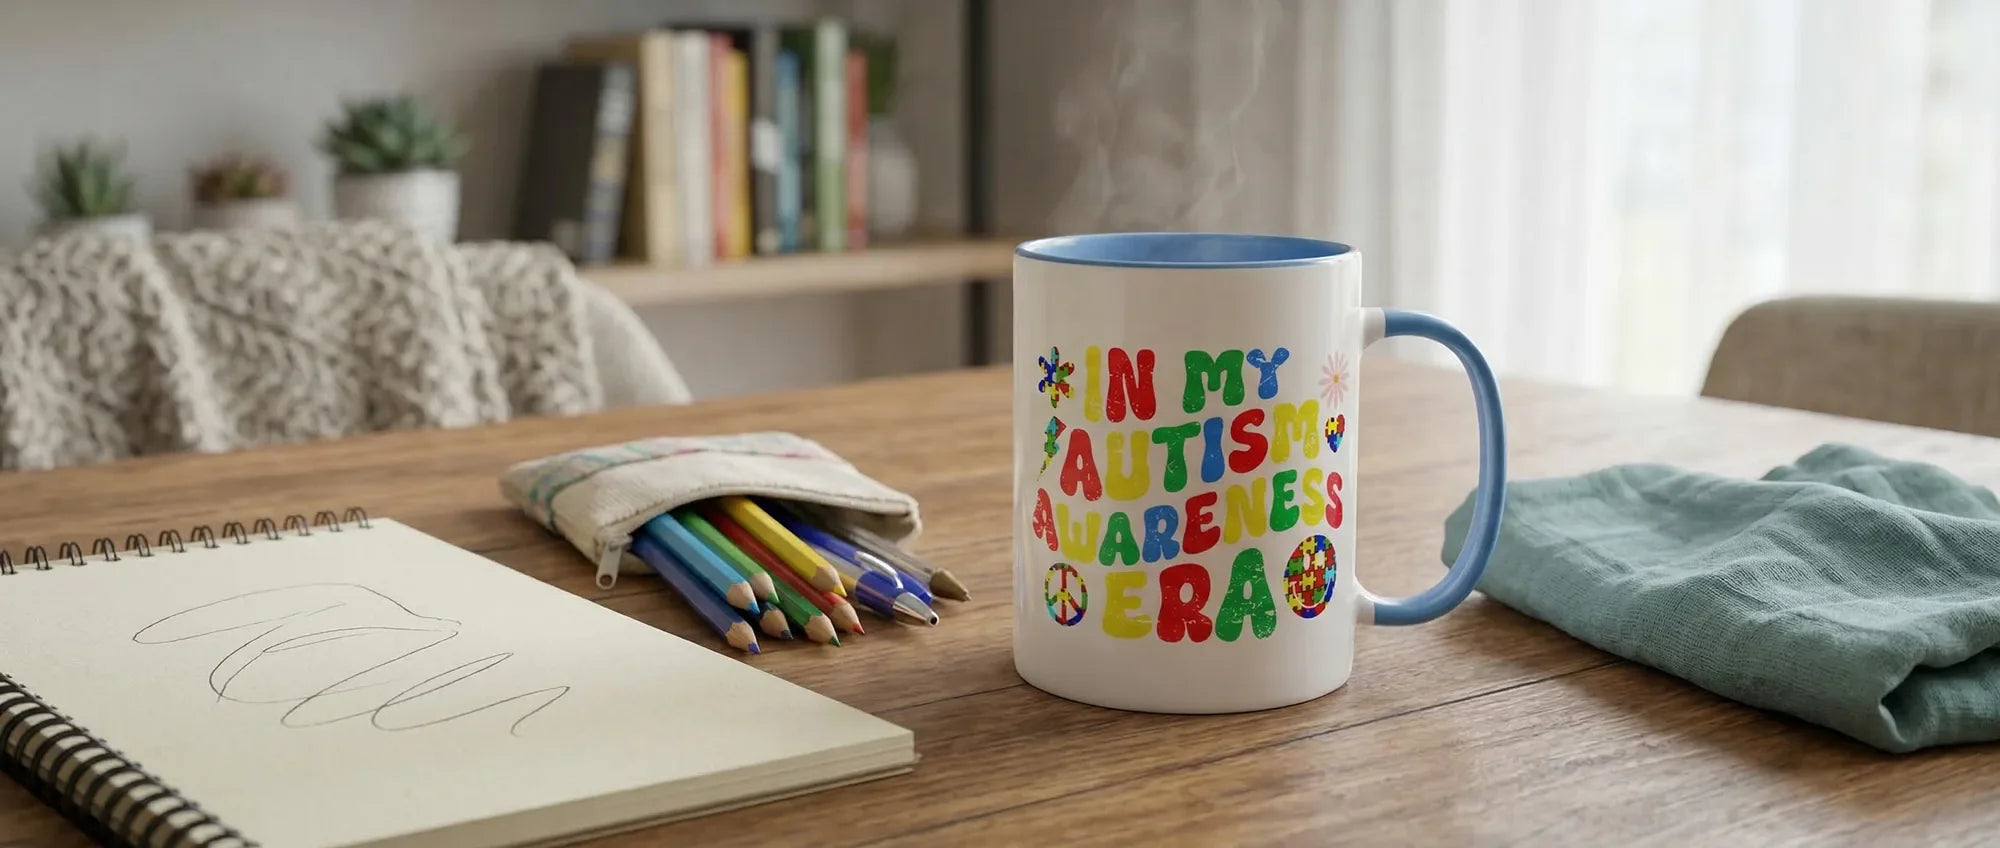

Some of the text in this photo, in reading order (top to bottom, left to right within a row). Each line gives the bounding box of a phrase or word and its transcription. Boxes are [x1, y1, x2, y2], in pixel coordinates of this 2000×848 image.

[1083, 345, 1290, 423] IN MY
[1060, 398, 1320, 501] AUTISM
[1032, 467, 1343, 566] AWARENESS
[1102, 547, 1277, 643] ERA
